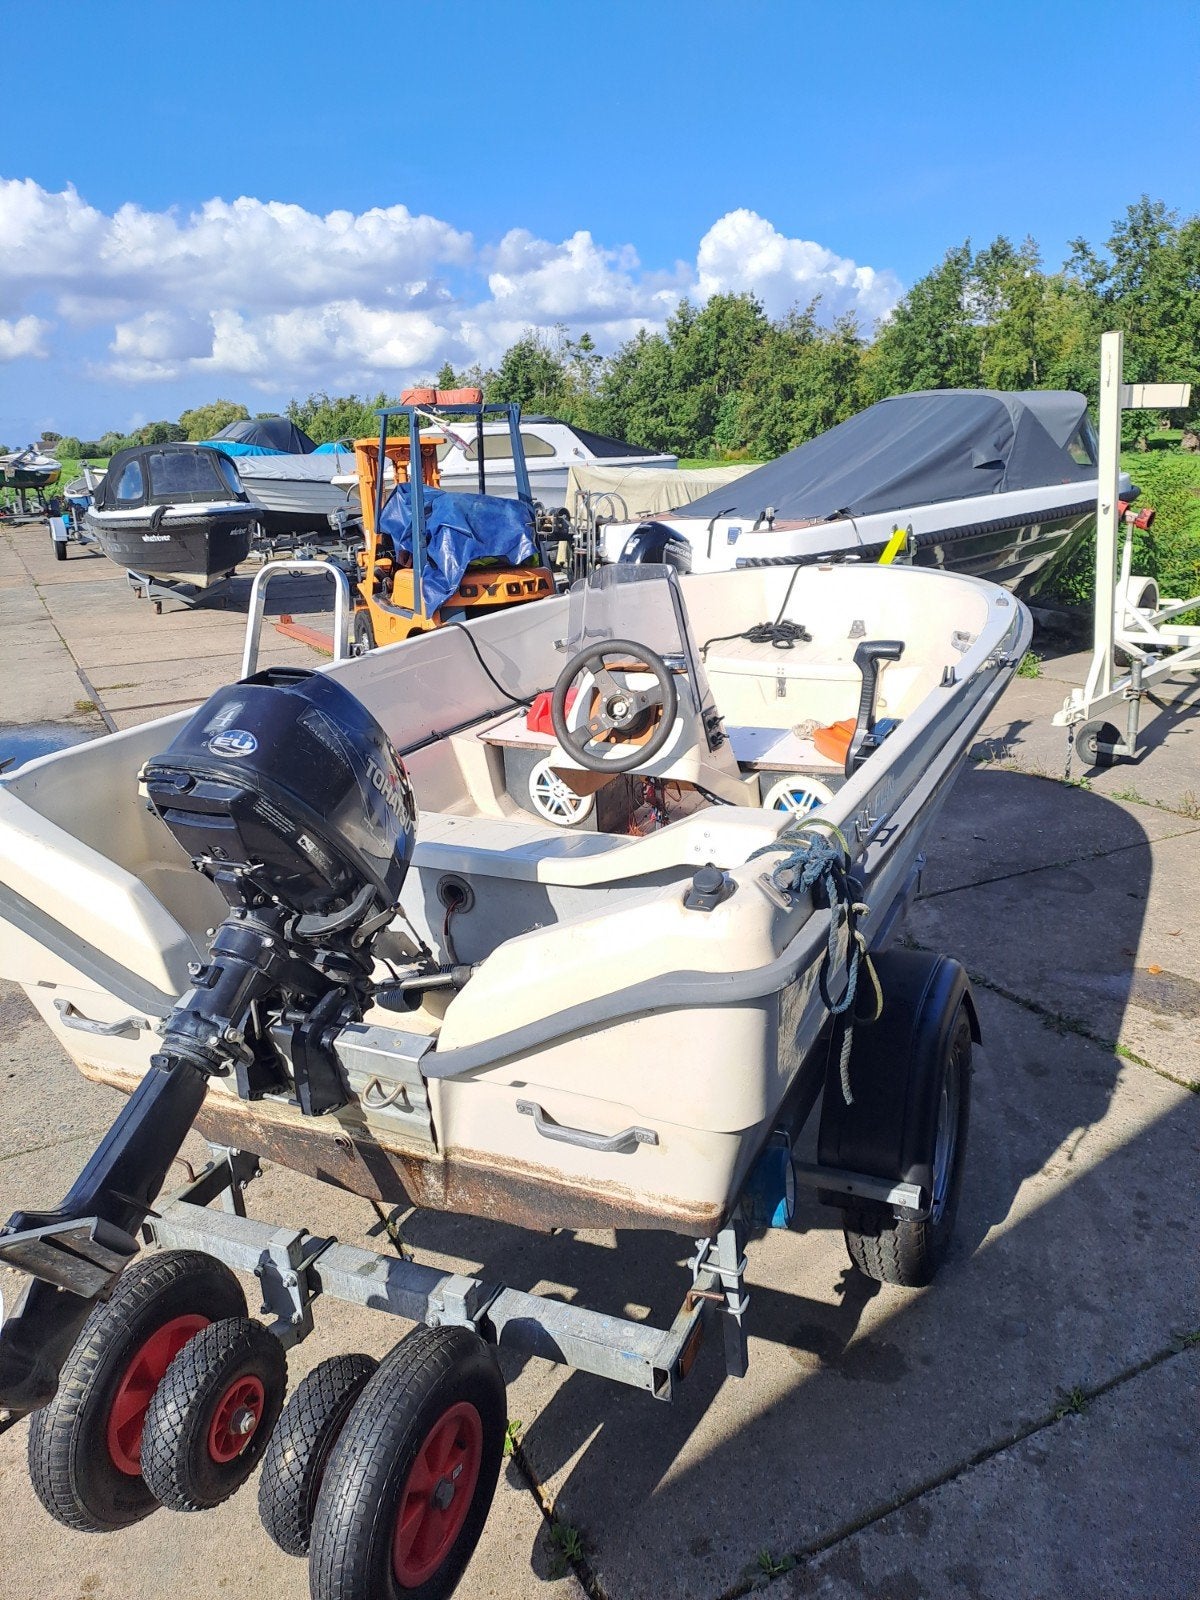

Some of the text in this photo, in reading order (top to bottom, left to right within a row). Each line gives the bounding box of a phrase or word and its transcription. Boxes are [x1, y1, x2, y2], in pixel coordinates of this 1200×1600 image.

[460, 578, 549, 597] OYOTA
[215, 703, 243, 727] 4
[213, 736, 254, 750] EU
[365, 757, 412, 836] TOHATSU
